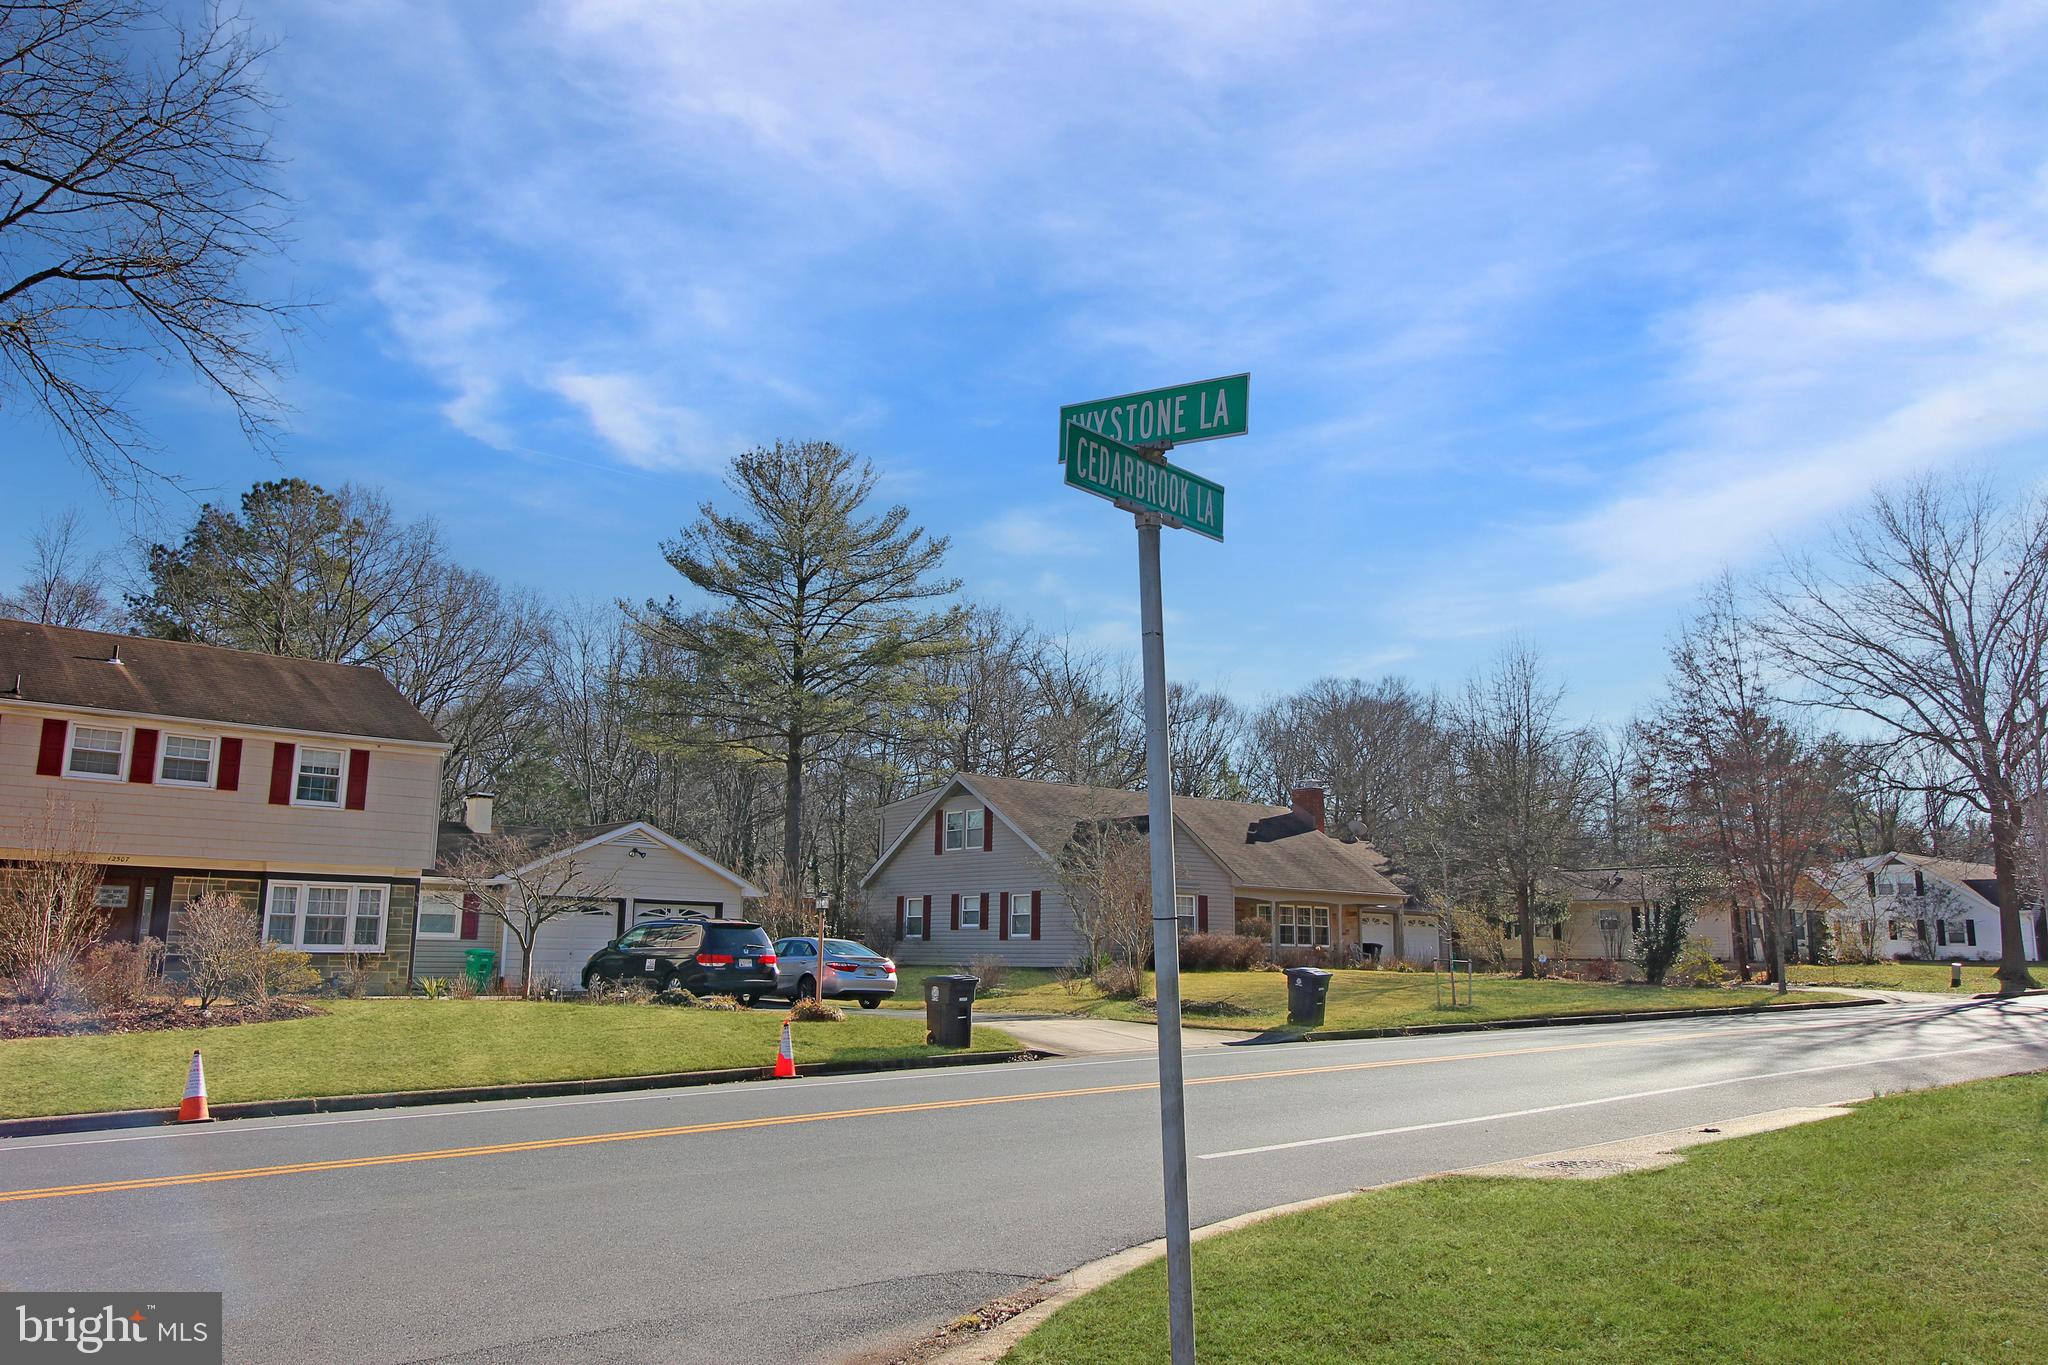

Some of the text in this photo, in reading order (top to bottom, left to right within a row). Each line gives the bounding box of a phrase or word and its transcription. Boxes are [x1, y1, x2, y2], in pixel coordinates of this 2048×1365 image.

[1072, 389, 1229, 441] YSTONE LA
[1077, 437, 1214, 526] CEDARBROOK LA
